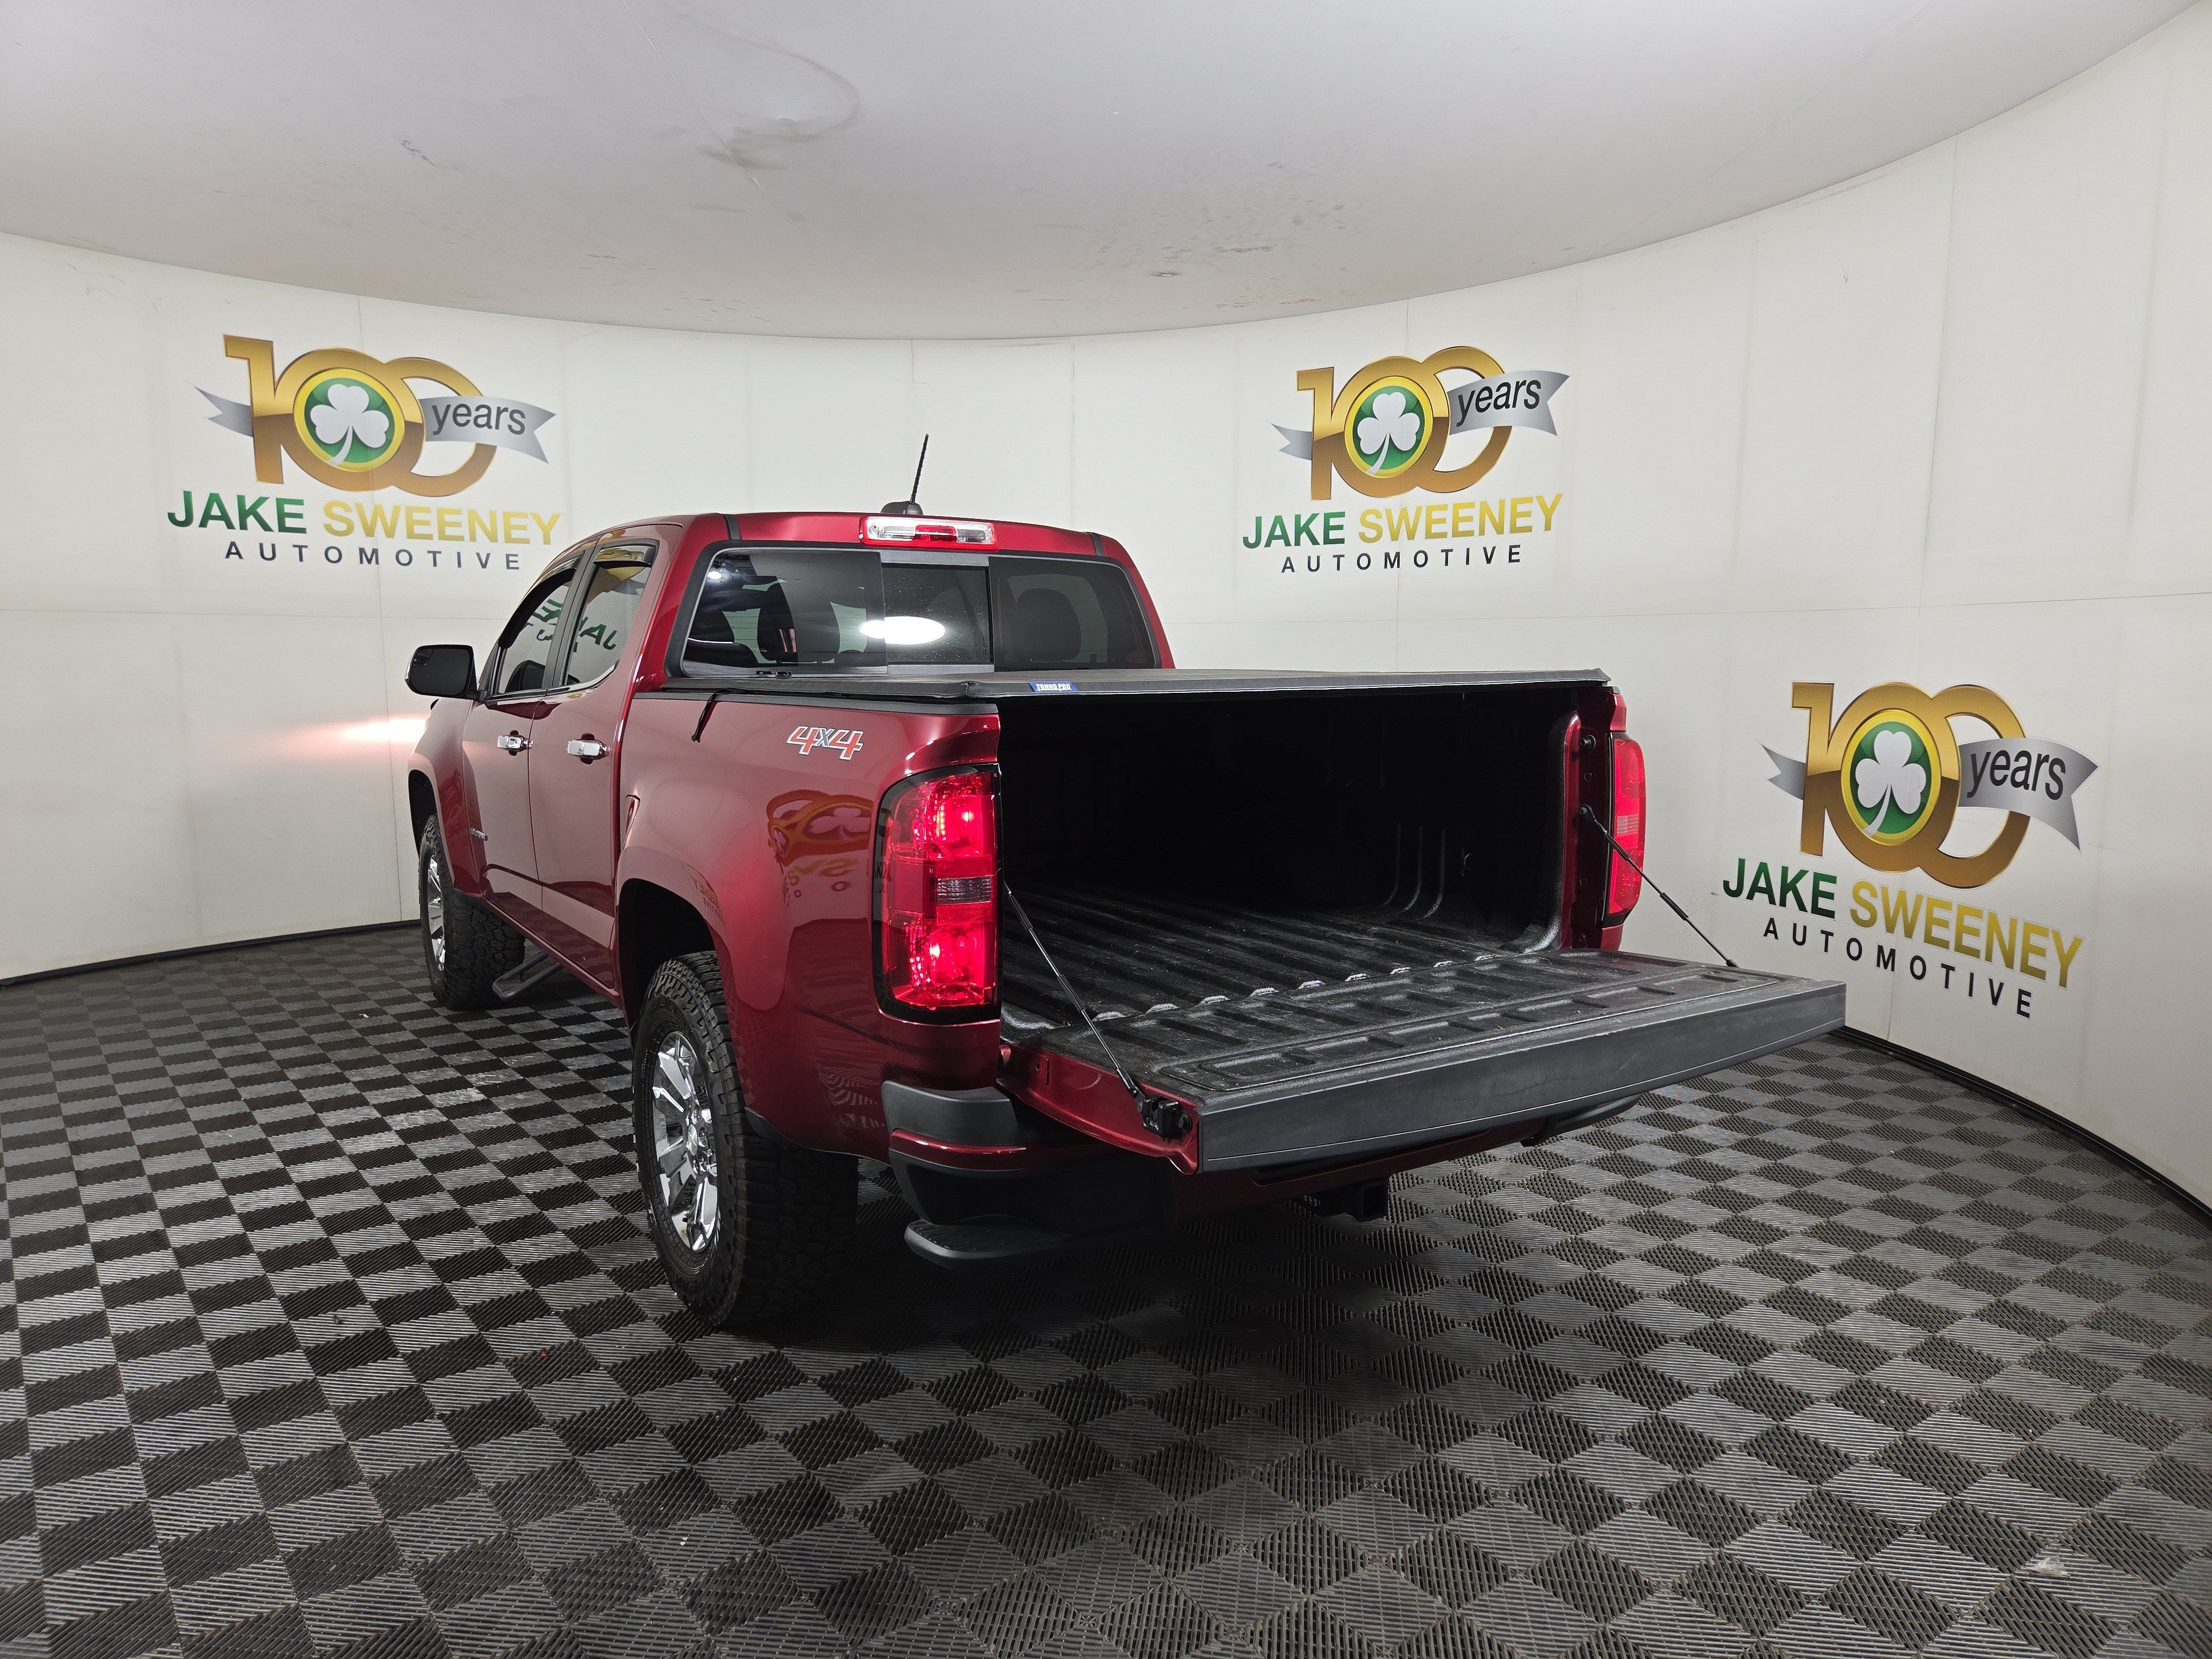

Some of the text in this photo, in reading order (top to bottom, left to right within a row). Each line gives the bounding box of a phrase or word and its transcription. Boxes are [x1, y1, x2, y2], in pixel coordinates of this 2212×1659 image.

[223, 334, 526, 497] 100 years
[1296, 345, 1541, 500] 100 years
[168, 490, 561, 545] JAKE SWEENEY
[225, 541, 520, 570] AUTOMOTIVE
[1243, 493, 1564, 549] JAKE SWEENEY
[1281, 544, 1521, 573] AUTOMOTIVE
[1036, 683, 1072, 691] TONNO PRO
[1791, 682, 2066, 889] 100 years
[1723, 858, 2084, 989] JAKE SWEENEY
[1764, 917, 2033, 1019] AUTOMOTIVE
